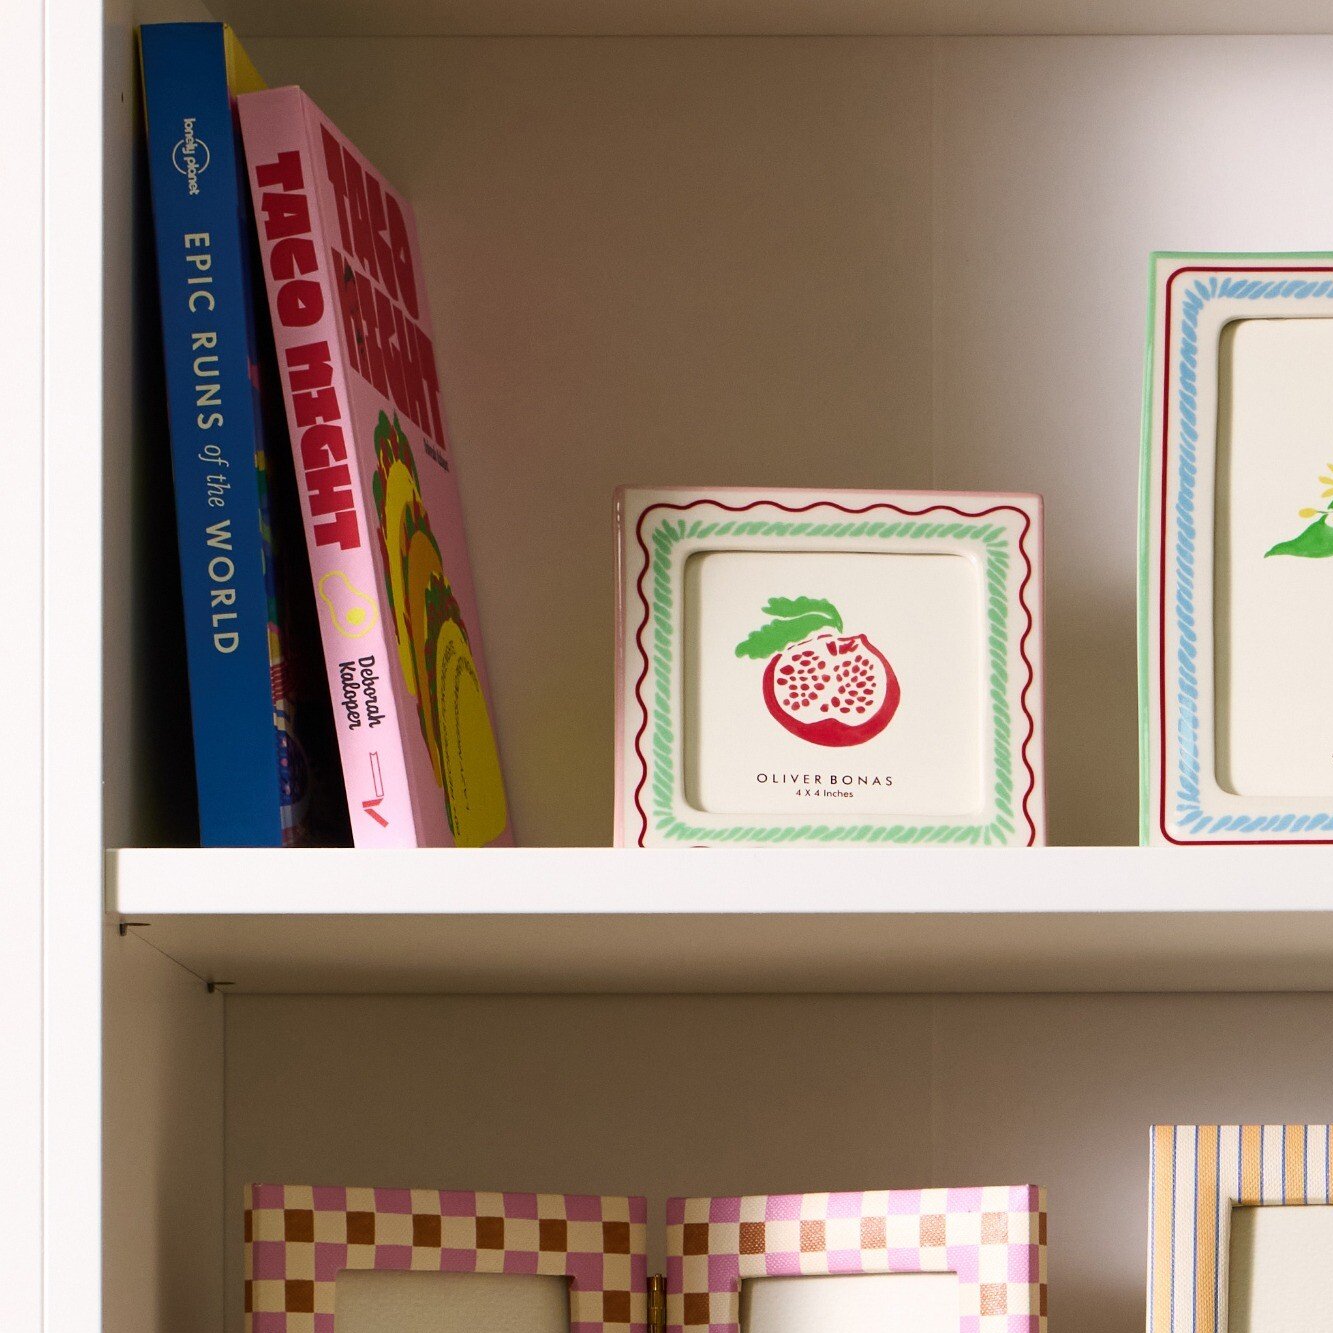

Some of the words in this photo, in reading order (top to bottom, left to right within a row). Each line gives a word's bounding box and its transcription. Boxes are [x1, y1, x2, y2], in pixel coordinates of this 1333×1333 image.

[182, 118, 197, 154] lonely
[184, 157, 200, 195] planet
[255, 150, 325, 327] TACO
[184, 232, 215, 313] EPIC
[191, 331, 224, 430] RUNS
[199, 444, 230, 467] of
[206, 473, 231, 507] the
[205, 519, 239, 654] WORLD
[338, 660, 361, 731] Kaloper
[357, 655, 386, 728] Deborah
[757, 773, 822, 784] OLIVER
[830, 775, 893, 786] BONAS
[823, 789, 854, 798] Inches
